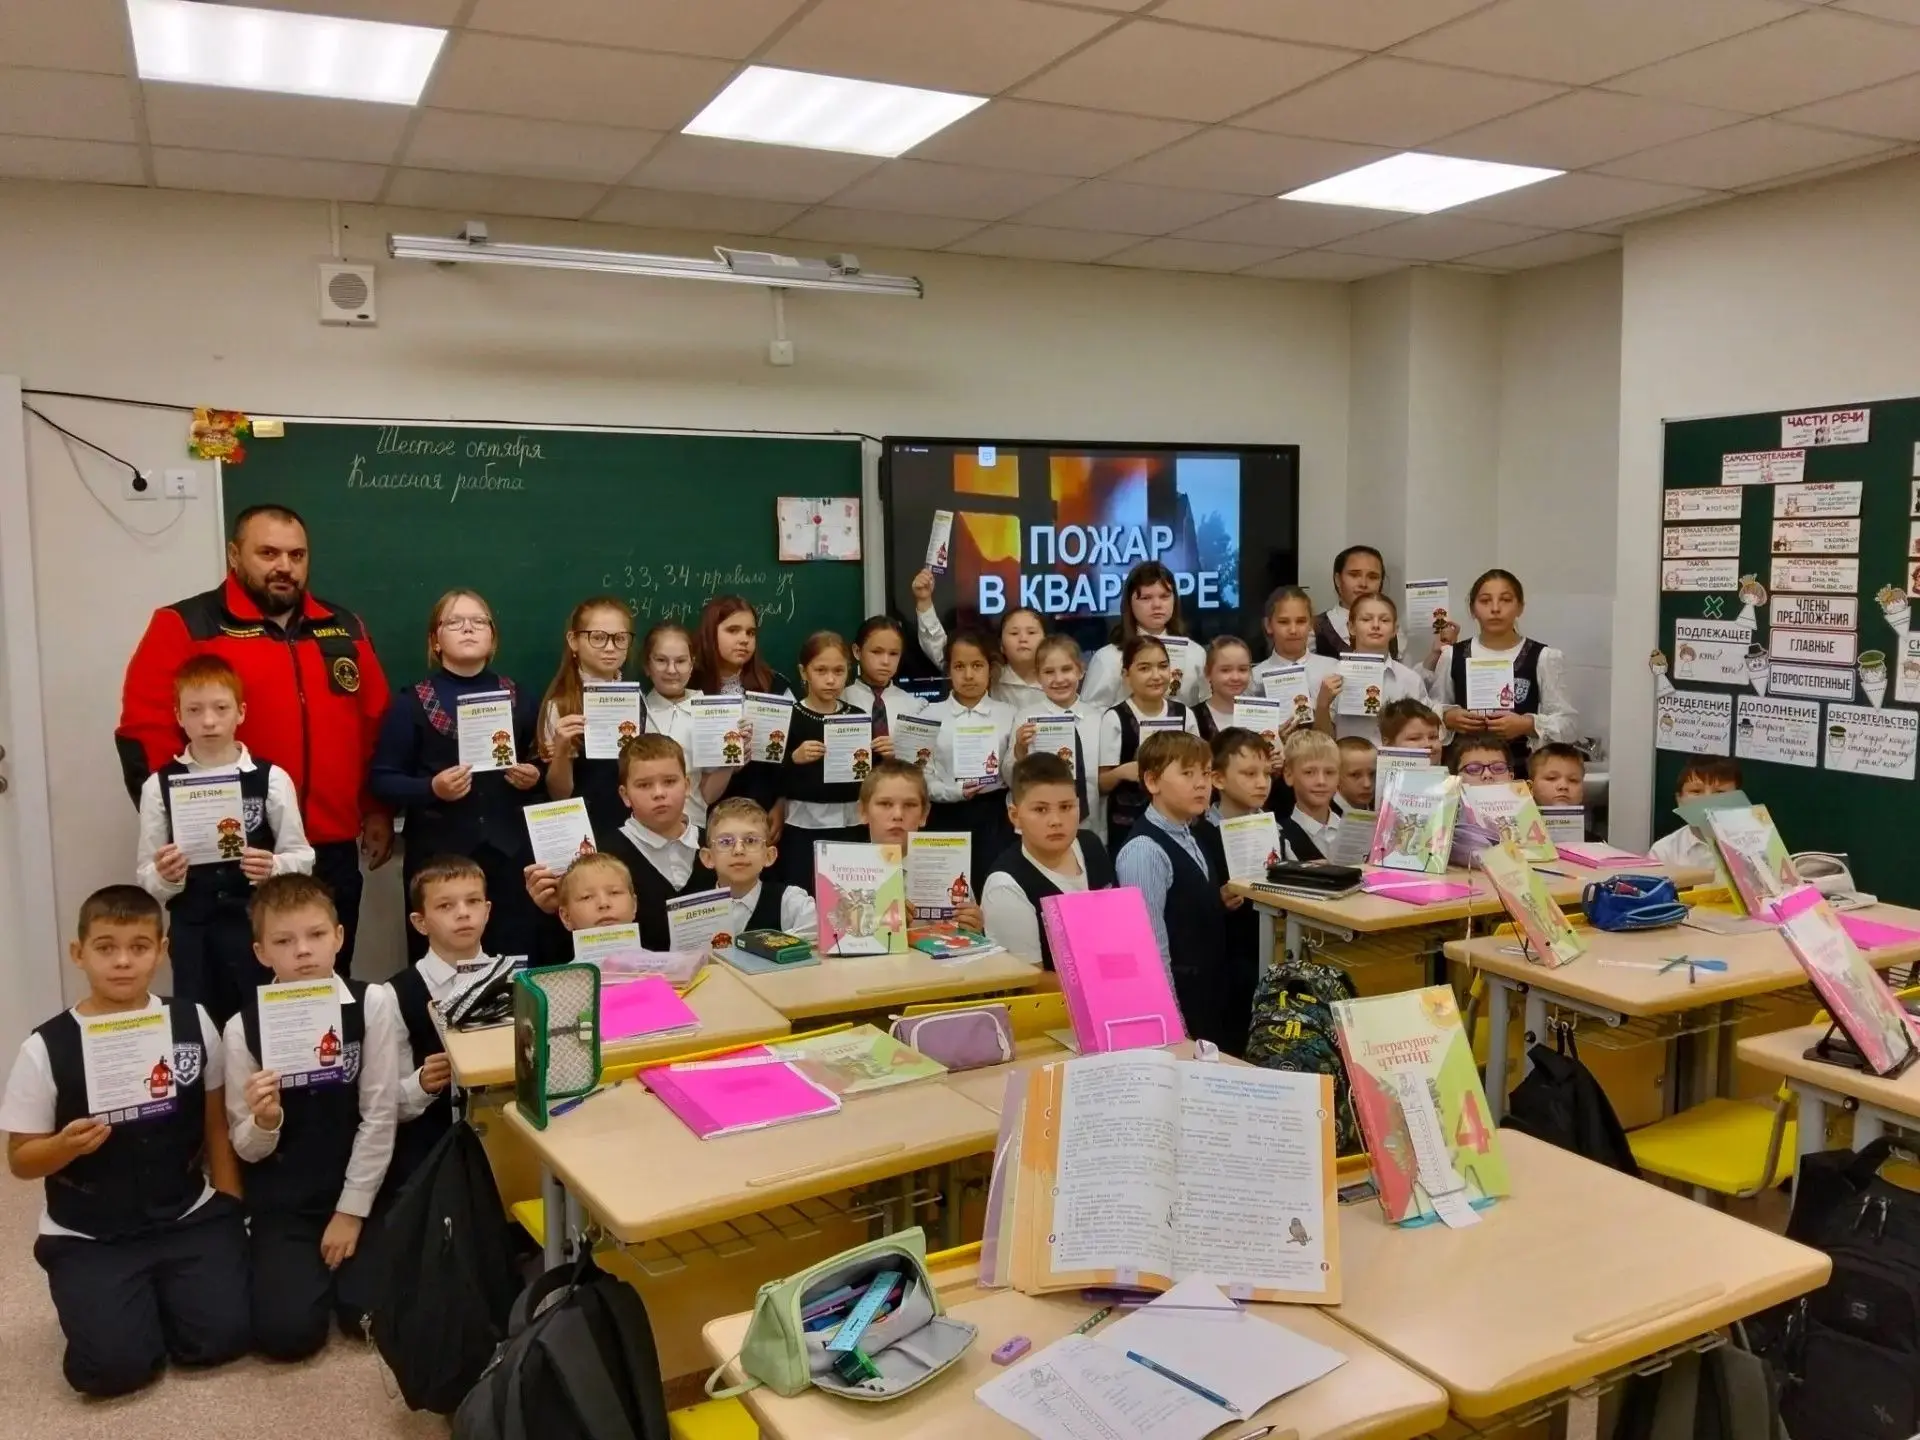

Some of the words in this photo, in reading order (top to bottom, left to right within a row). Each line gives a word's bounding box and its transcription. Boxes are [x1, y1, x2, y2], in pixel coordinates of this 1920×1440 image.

[1787, 415, 1828, 428] ЧАСТИ
[1832, 411, 1864, 424] РЕЧИ
[376, 426, 456, 455] Шестое
[466, 435, 546, 468] октября
[1724, 451, 1804, 462] САМОСТОЯТЕЛЬНЫЕ
[347, 453, 445, 490] Классная
[450, 462, 525, 503] работа
[1030, 525, 1174, 565] ПОЖАР
[978, 575, 1006, 615] В
[1020, 571, 1220, 613] КВАРРЕ
[1796, 599, 1830, 612] ЧЛЕНЫ
[1776, 610, 1849, 626] ПРЕДЛОЖЕНИЯ
[1678, 626, 1750, 641] ПОДЛЕЖАЩЕЕ
[1790, 638, 1836, 654] ГЛАВНЫЕ
[1772, 672, 1850, 690] ВТОРОСТЕПЕННЫЕ
[598, 696, 625, 704] ДЕТЯМ
[1658, 696, 1730, 712] ОПРЕДЕЛЕНИЕ
[471, 706, 497, 716] ДЕТЯМ
[1740, 702, 1818, 718] ДОПОЛНЕНИЕ
[1828, 710, 1917, 727] ОБСТОЯТЕЛЬСТВО
[189, 788, 222, 800] ДЕТЯМ
[1526, 819, 1546, 845] 4
[684, 906, 716, 920] ДЕТЯМ
[879, 899, 903, 933] 4
[1361, 1034, 1438, 1056] Литературное
[1455, 1089, 1490, 1155] 4
